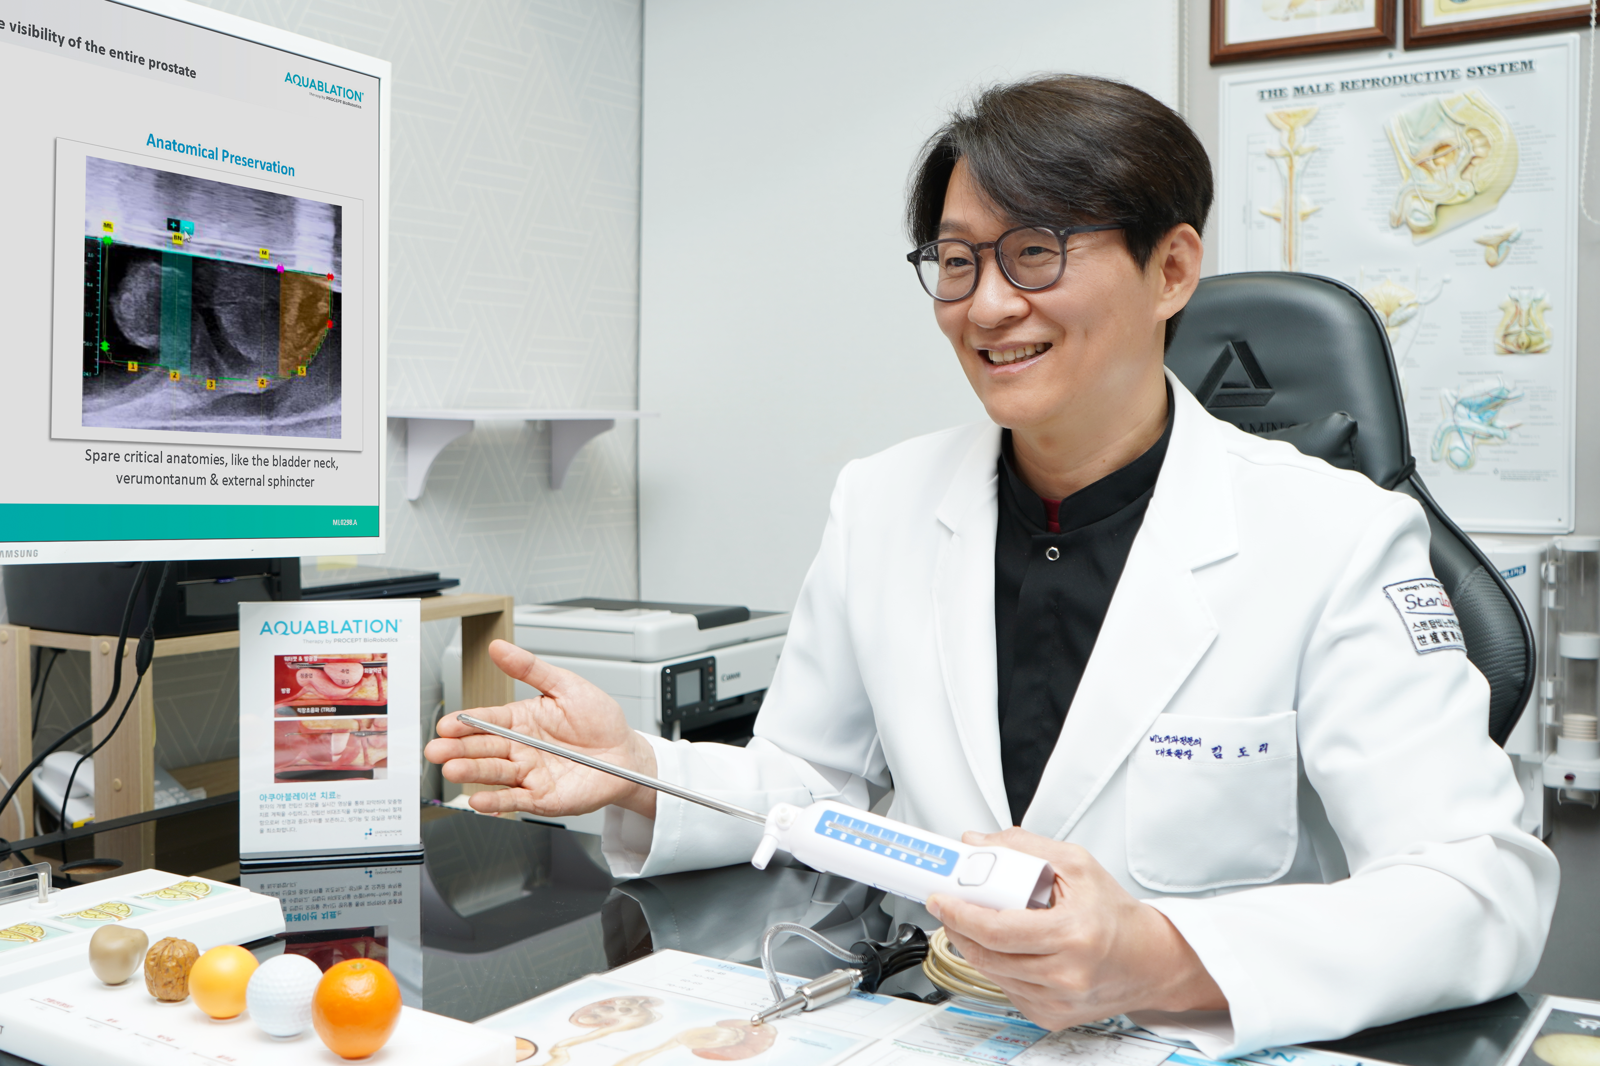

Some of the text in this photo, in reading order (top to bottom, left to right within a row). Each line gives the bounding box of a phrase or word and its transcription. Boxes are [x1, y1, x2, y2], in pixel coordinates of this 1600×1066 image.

[10, 21, 64, 47] visibility
[68, 36, 82, 49] of
[84, 40, 106, 55] the
[109, 49, 146, 66] entire
[148, 58, 196, 78] prostate
[1258, 59, 1535, 100] THE MALE REPRODUCTIVE SYSTEM
[146, 133, 295, 178] Anatomical Preservation
[85, 449, 338, 470] Spare critical anatomies, like the bladder neck,
[116, 473, 314, 489] verumontanum & external sphincter
[0, 549, 38, 558] AMSUNG
[259, 619, 398, 636] AQUABLATION
[1211, 745, 1223, 759] 김
[259, 792, 317, 802] 아쿠아블레이션
